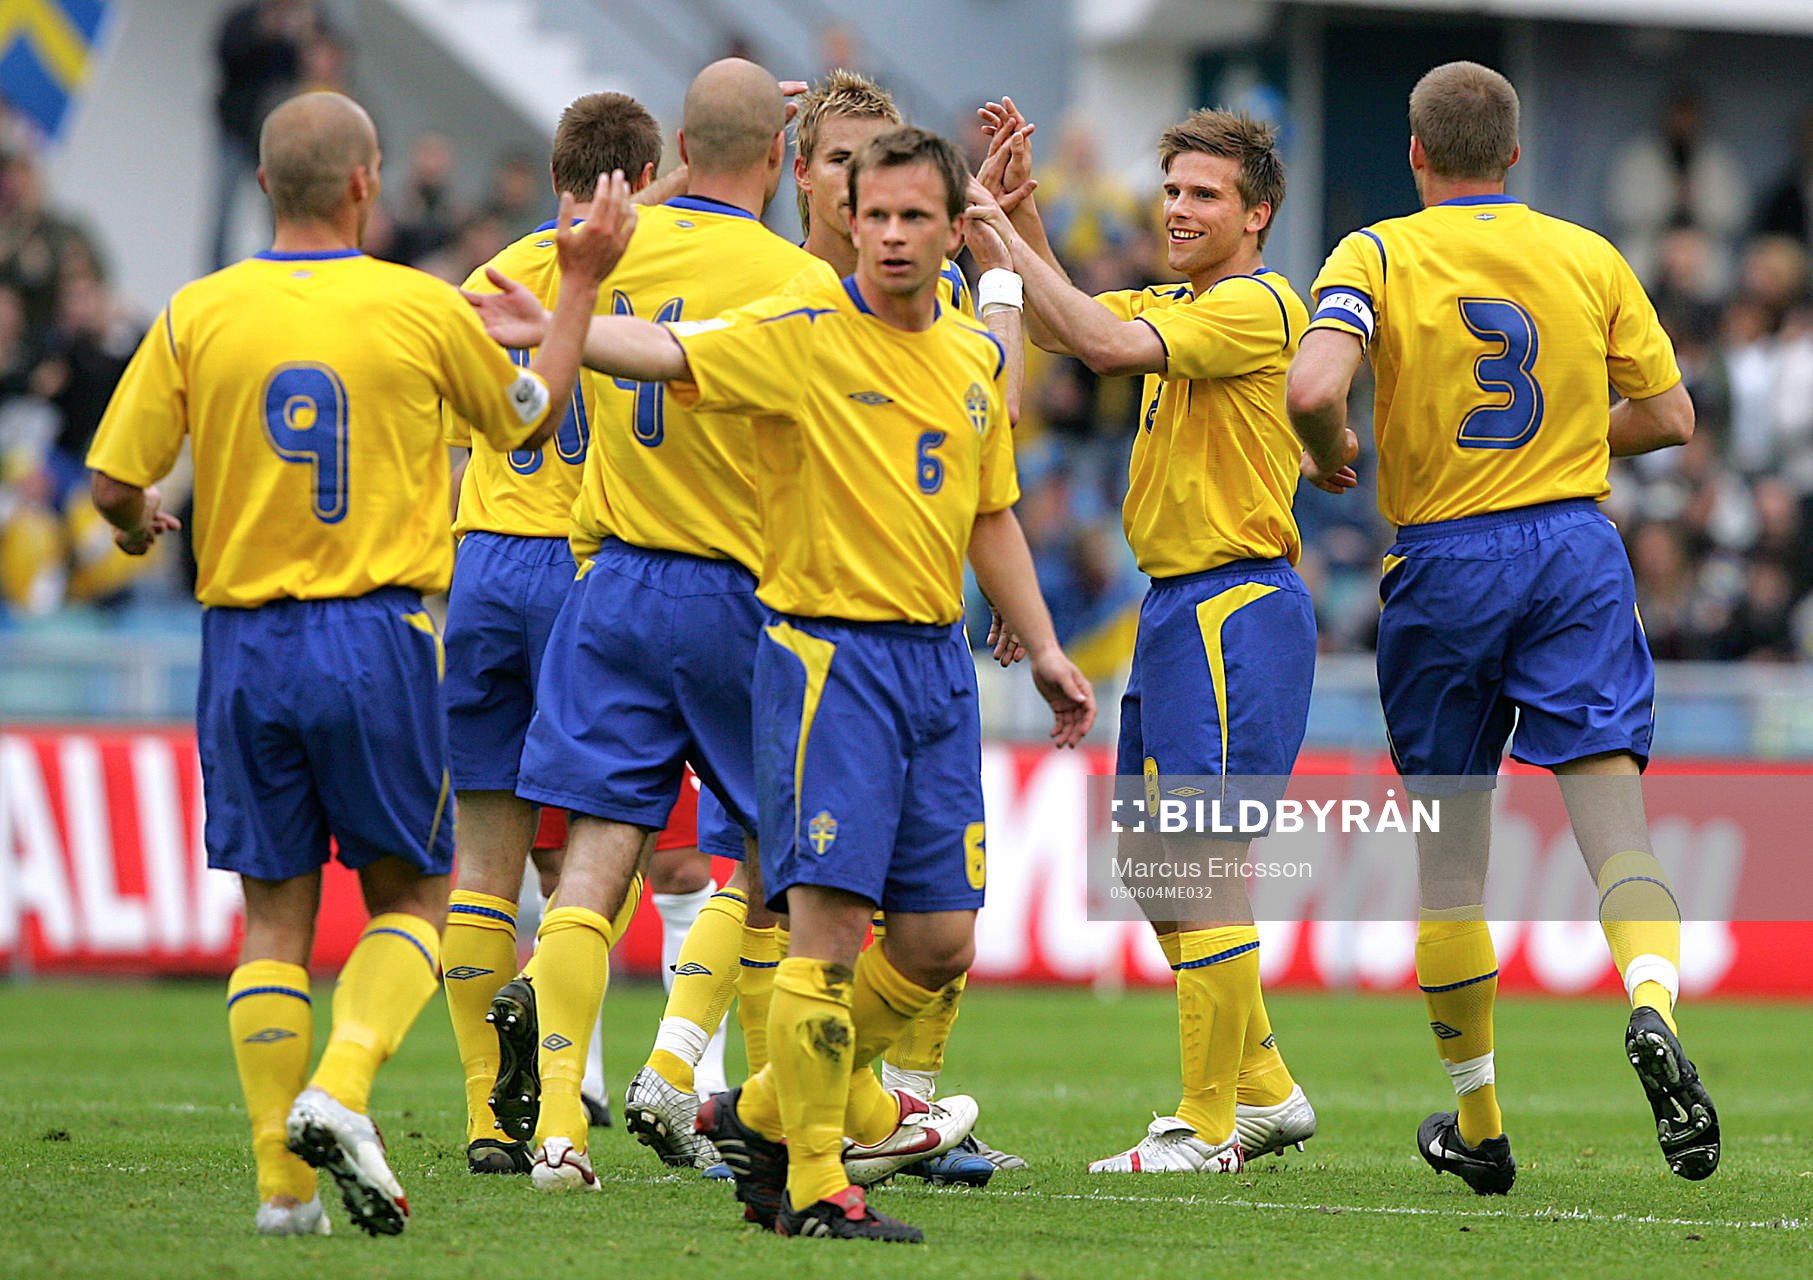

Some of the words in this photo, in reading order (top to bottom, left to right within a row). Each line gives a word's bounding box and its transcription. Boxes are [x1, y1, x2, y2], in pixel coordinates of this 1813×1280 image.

[1326, 296, 1363, 313] TEN
[1456, 297, 1544, 449] 3
[259, 360, 349, 524] 9
[917, 430, 947, 495] 6
[1143, 756, 1161, 818] 8
[963, 821, 986, 891] 6
